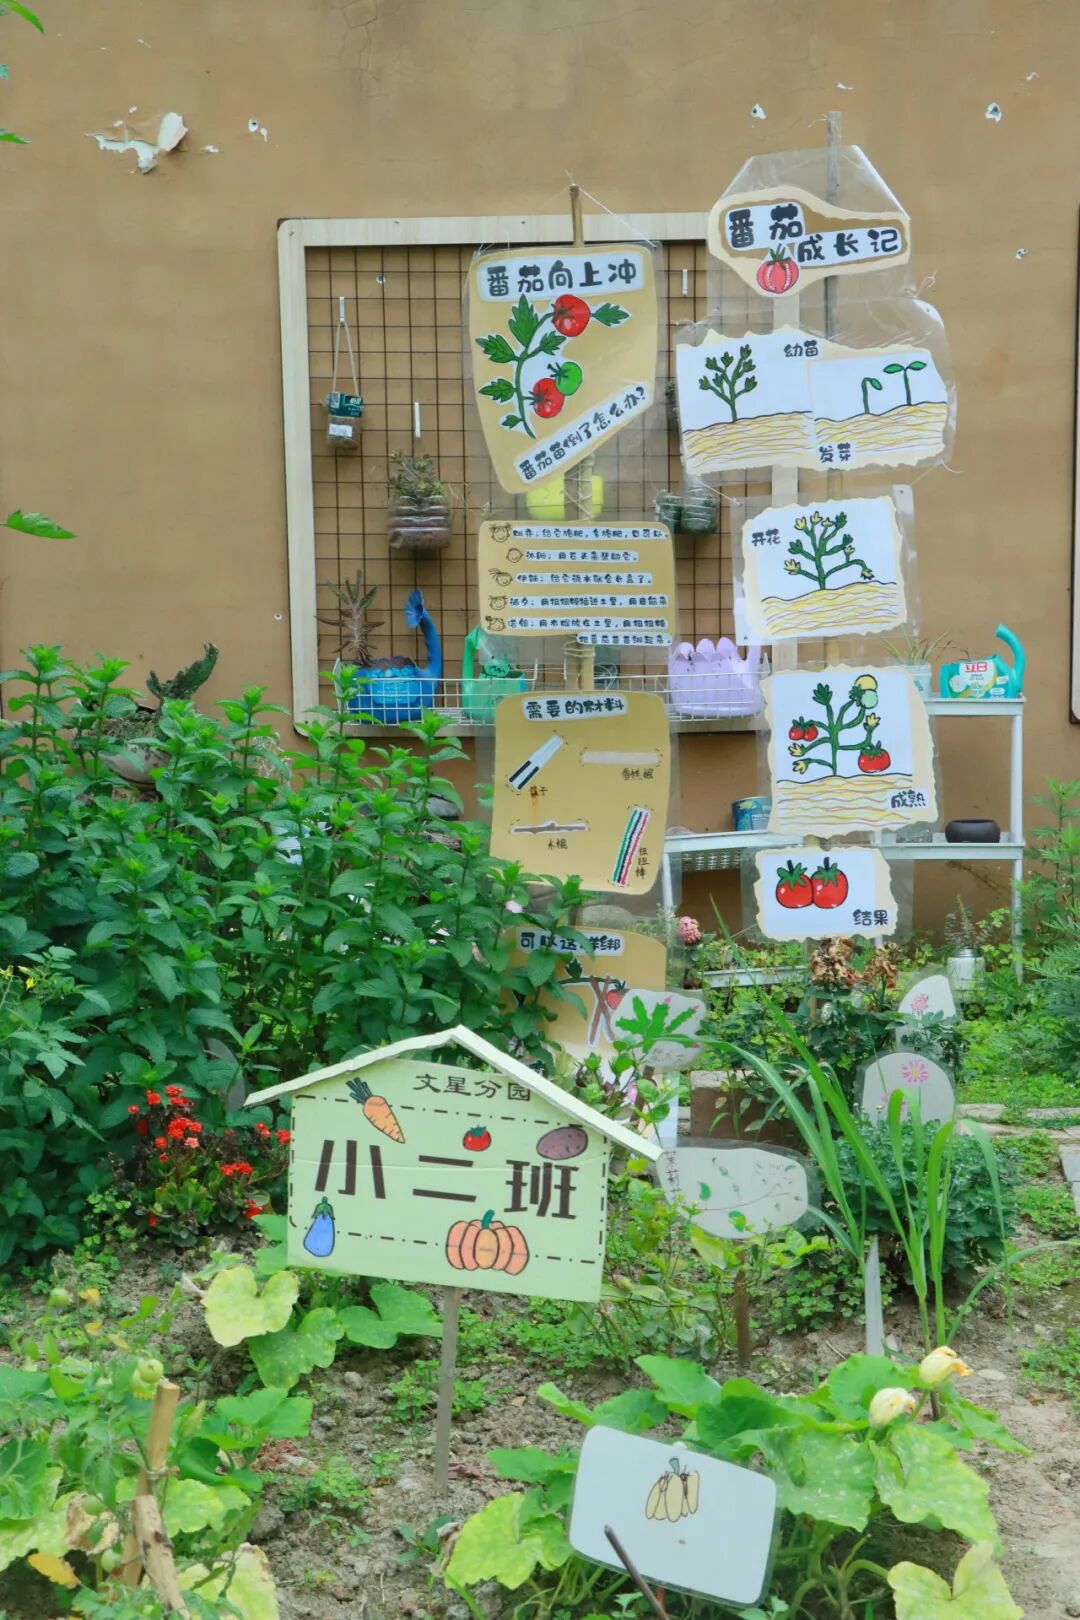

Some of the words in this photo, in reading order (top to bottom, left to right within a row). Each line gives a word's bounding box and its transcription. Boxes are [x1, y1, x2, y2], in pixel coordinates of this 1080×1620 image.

[729, 203, 803, 248] 番茄
[798, 228, 898, 262] 成长记
[487, 258, 636, 297] 番茄向上冲
[783, 340, 819, 358] 幼苗
[819, 443, 851, 462] 发芽
[751, 528, 781, 547] 开花
[525, 697, 625, 719] 需要的材料
[890, 790, 926, 809] 成熟
[853, 909, 888, 927] 结果
[413, 1072, 532, 1102] 文星分园
[315, 1139, 579, 1220] 小二班
